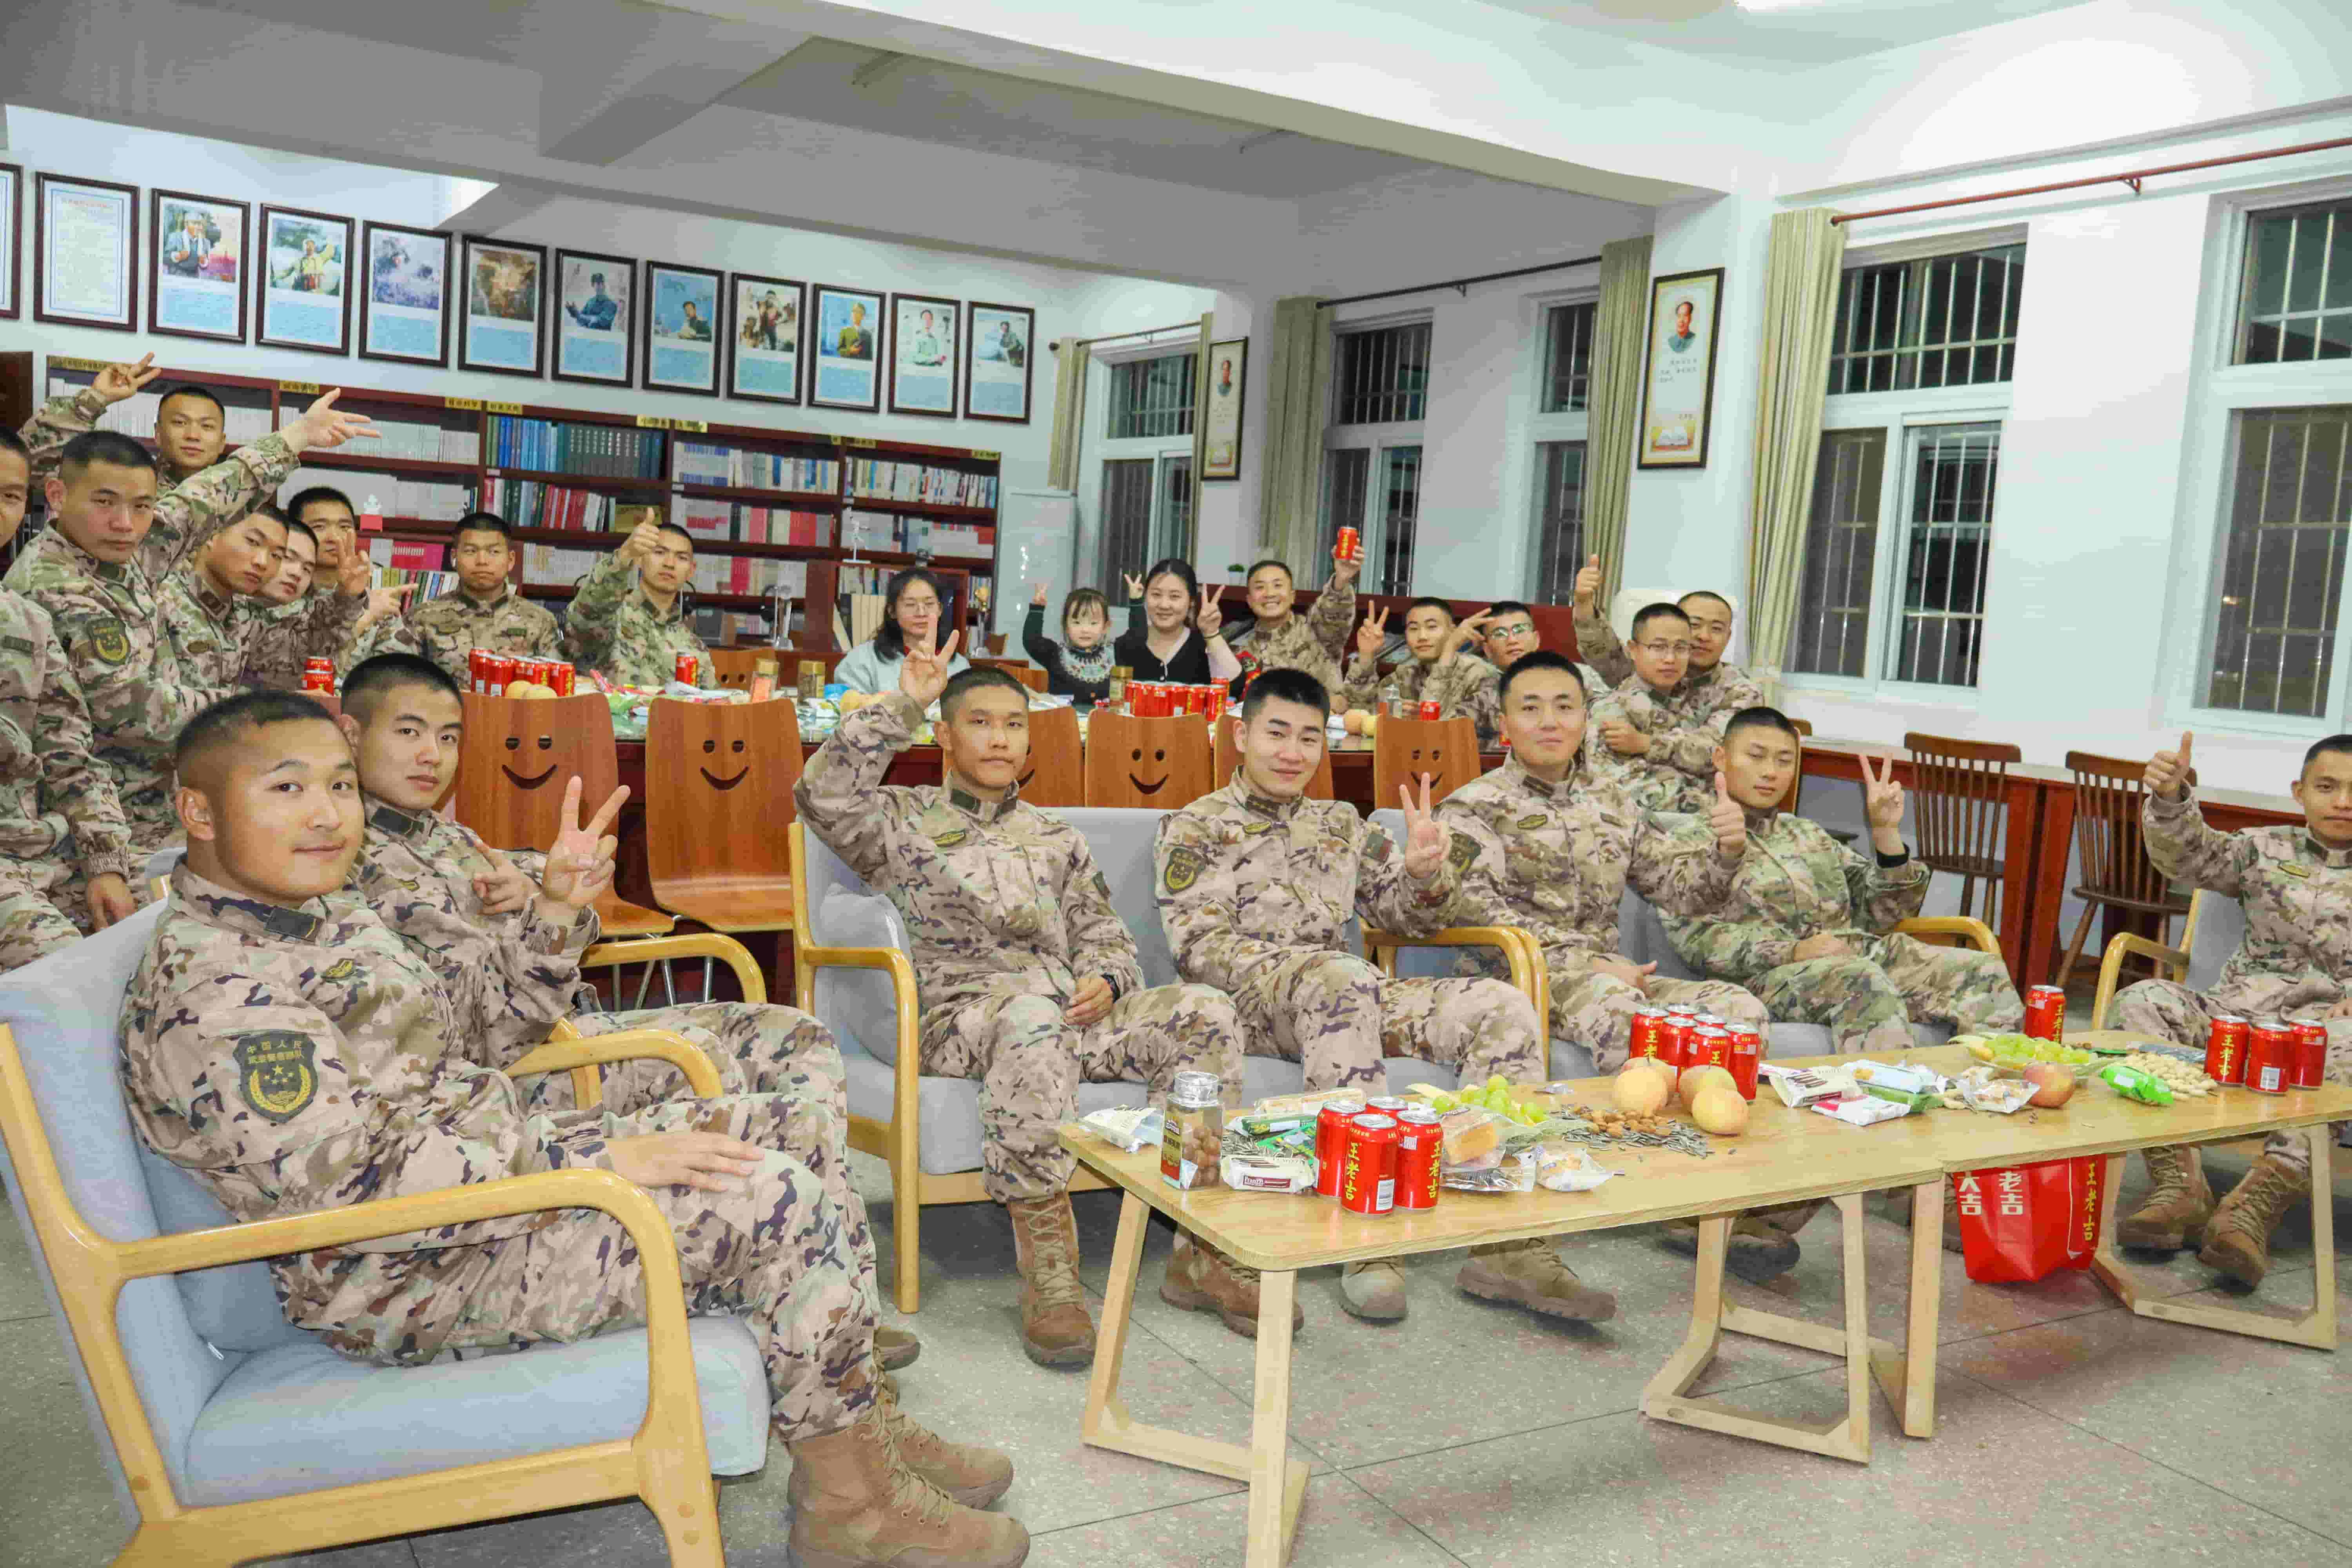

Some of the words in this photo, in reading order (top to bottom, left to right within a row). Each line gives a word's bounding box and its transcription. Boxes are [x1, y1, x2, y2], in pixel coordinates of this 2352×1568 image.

[1643, 1030, 1658, 1059] 王老
[1345, 1142, 1361, 1201] 王老吉
[1426, 1141, 1441, 1198] 王老吉
[1999, 1171, 2023, 1216] 老吉
[2083, 1163, 2097, 1242] 王老吉
